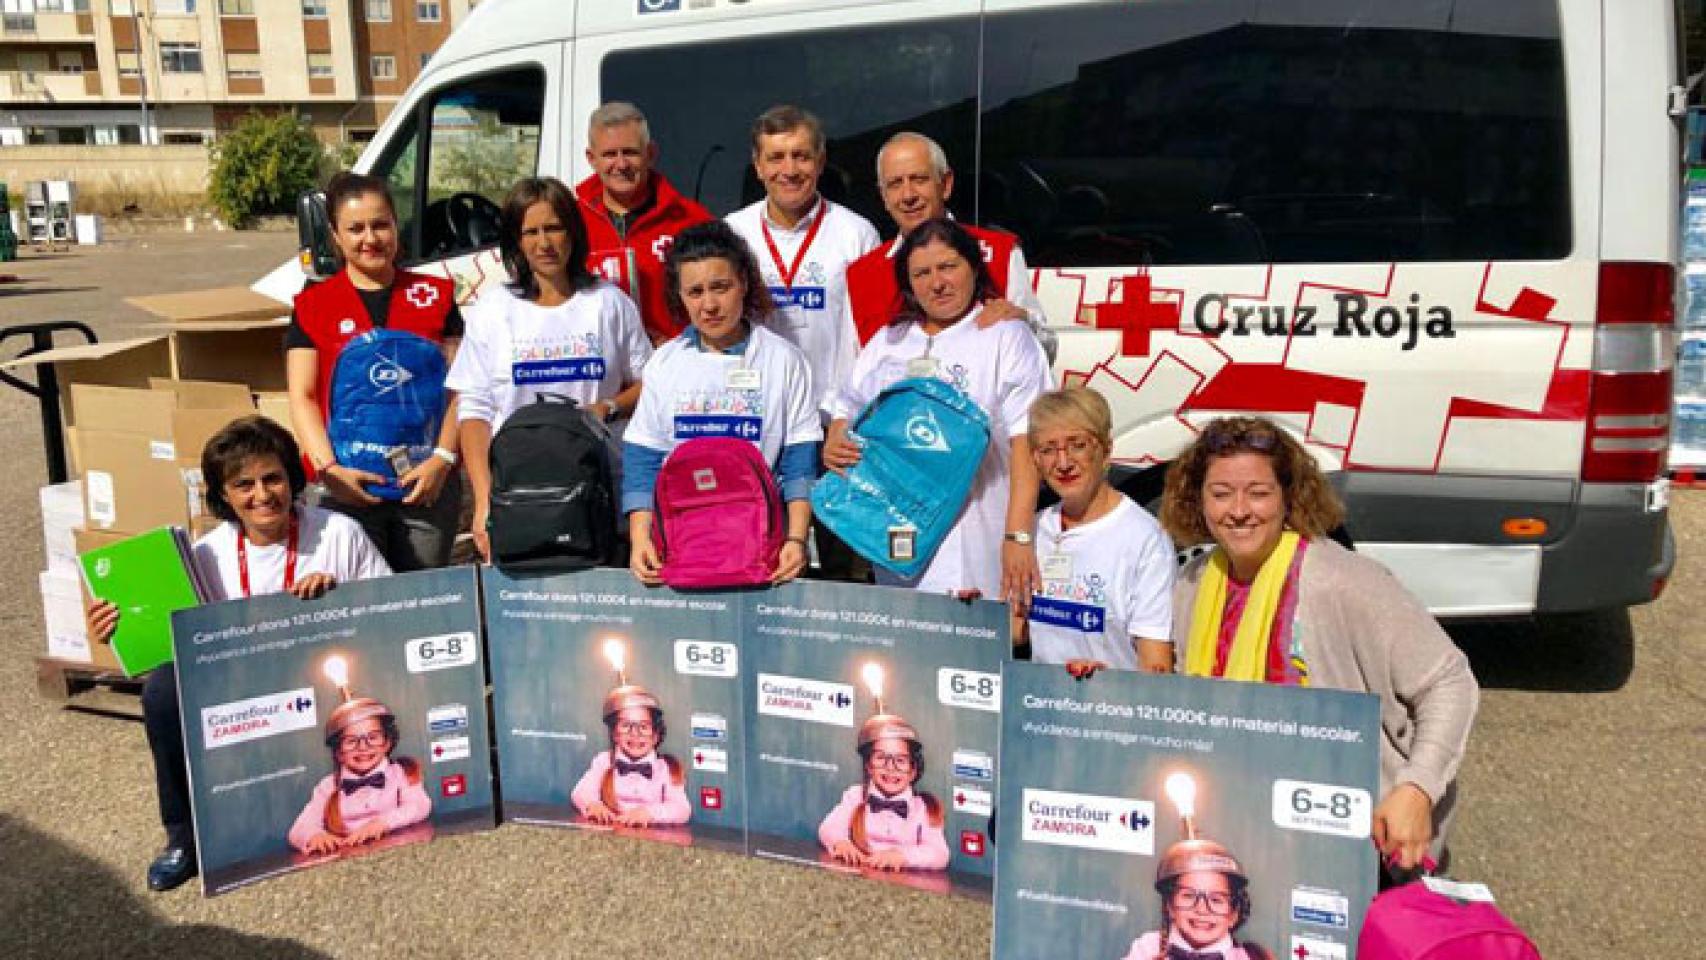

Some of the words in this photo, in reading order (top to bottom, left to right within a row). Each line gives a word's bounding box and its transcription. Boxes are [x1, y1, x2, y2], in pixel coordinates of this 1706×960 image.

[1194, 293, 1317, 338] Cruz
[1333, 292, 1456, 350] Roja
[499, 589, 550, 602] Carrefour
[756, 604, 809, 619] Carrefour
[194, 623, 256, 645] Carrefour
[258, 618, 290, 633] dona
[761, 681, 824, 702] Carrefour
[208, 703, 281, 728] Carrefour
[1022, 694, 1093, 715] Carrefour
[1096, 703, 1134, 718] dona
[1137, 704, 1207, 726] 121.000€
[1210, 715, 1229, 728] en
[1232, 715, 1298, 736] material
[212, 718, 270, 738] ZAMORA
[1028, 800, 1112, 823] Carrefour
[1032, 818, 1097, 837] ZAMORA
